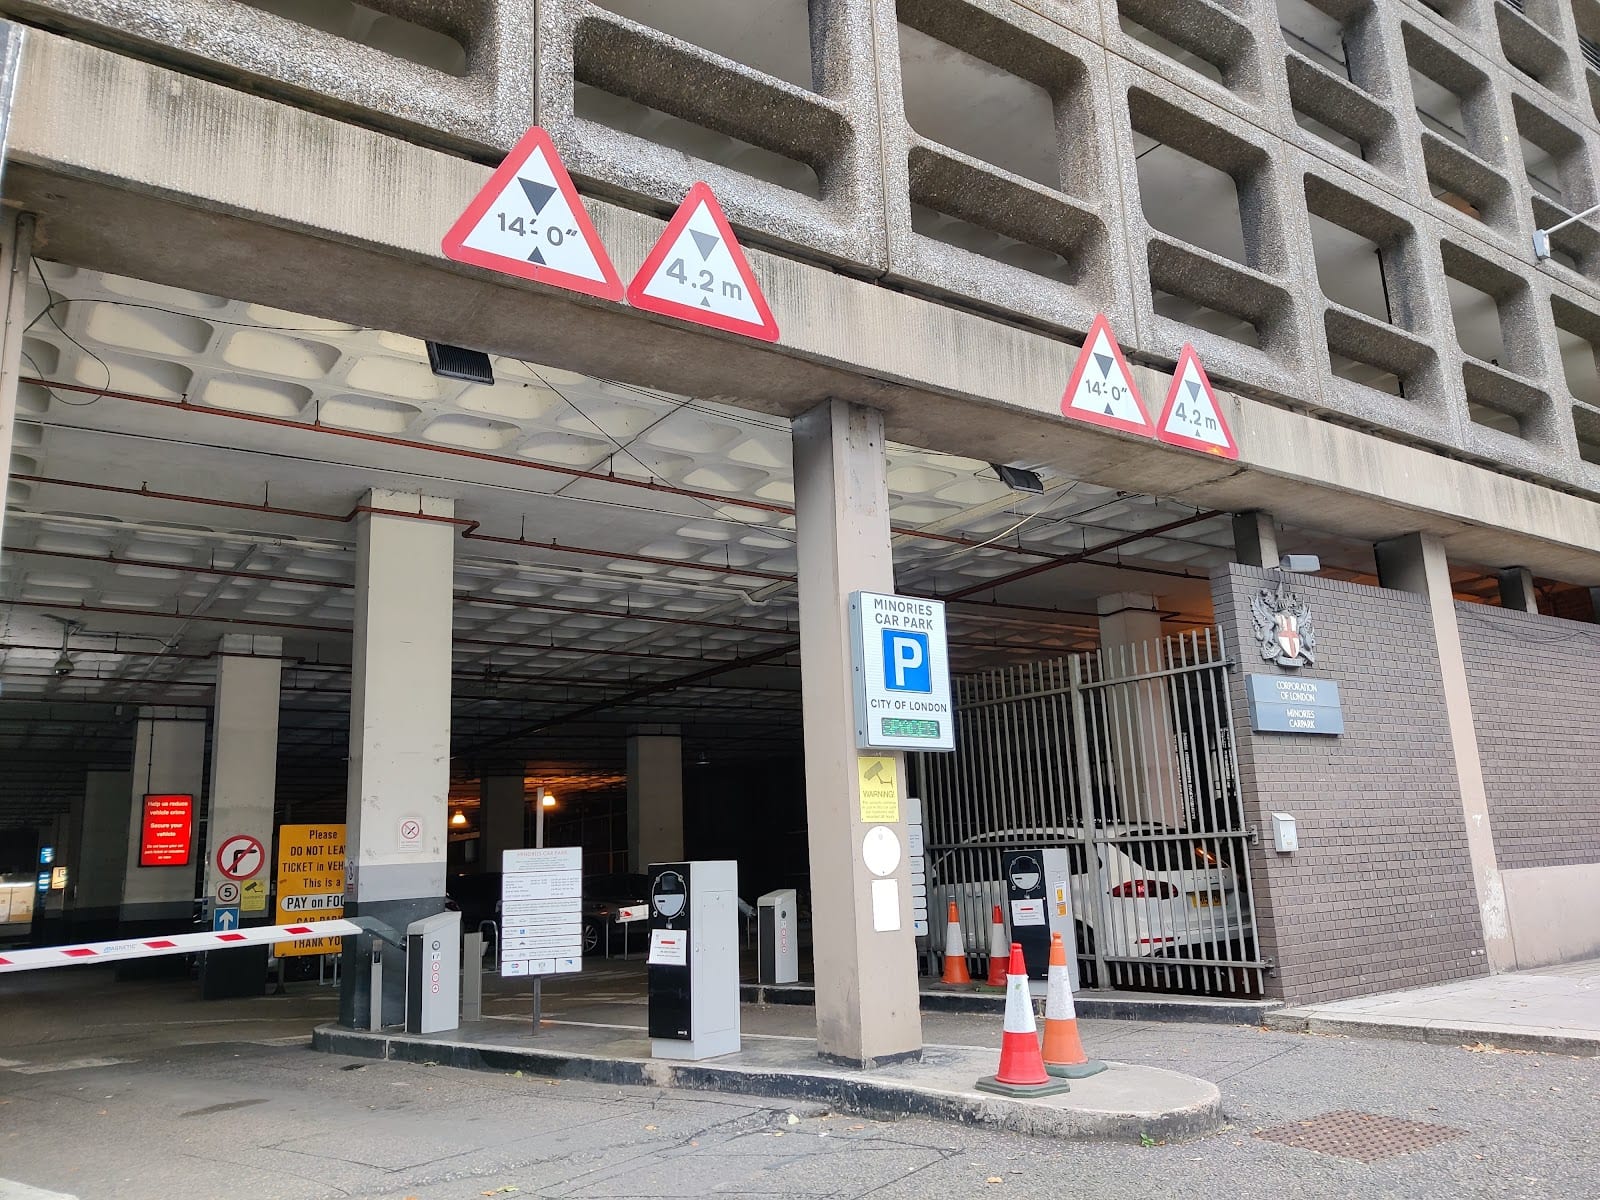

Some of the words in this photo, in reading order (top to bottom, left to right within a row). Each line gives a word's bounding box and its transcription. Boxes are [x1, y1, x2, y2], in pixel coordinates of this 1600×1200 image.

[666, 257, 714, 293] 4.2
[722, 279, 742, 301] m
[1175, 402, 1202, 427] 4.2
[1205, 417, 1217, 431] m
[874, 598, 933, 616] MINORIES
[875, 613, 899, 627] CAR
[903, 616, 934, 630] PARK
[893, 636, 922, 687] P
[1276, 680, 1317, 692] CORPORATION
[1280, 691, 1289, 700] OF
[1290, 692, 1316, 702] LONDON
[870, 698, 891, 709] CITY
[894, 700, 906, 710] OF
[909, 701, 947, 713] LONDON
[1286, 708, 1315, 719] MINORIES
[309, 829, 338, 840] Please
[290, 846, 302, 857] DO
[306, 845, 324, 856] NOT
[327, 845, 346, 855] LEA
[282, 861, 313, 873] TICKET
[316, 862, 324, 872] in
[327, 861, 345, 871] VEH
[303, 878, 322, 889] This
[325, 878, 332, 887] is
[224, 887, 232, 898] 5
[287, 896, 308, 910] PAY
[311, 898, 323, 908] on
[326, 895, 345, 907] FOO
[328, 935, 343, 947] YO
